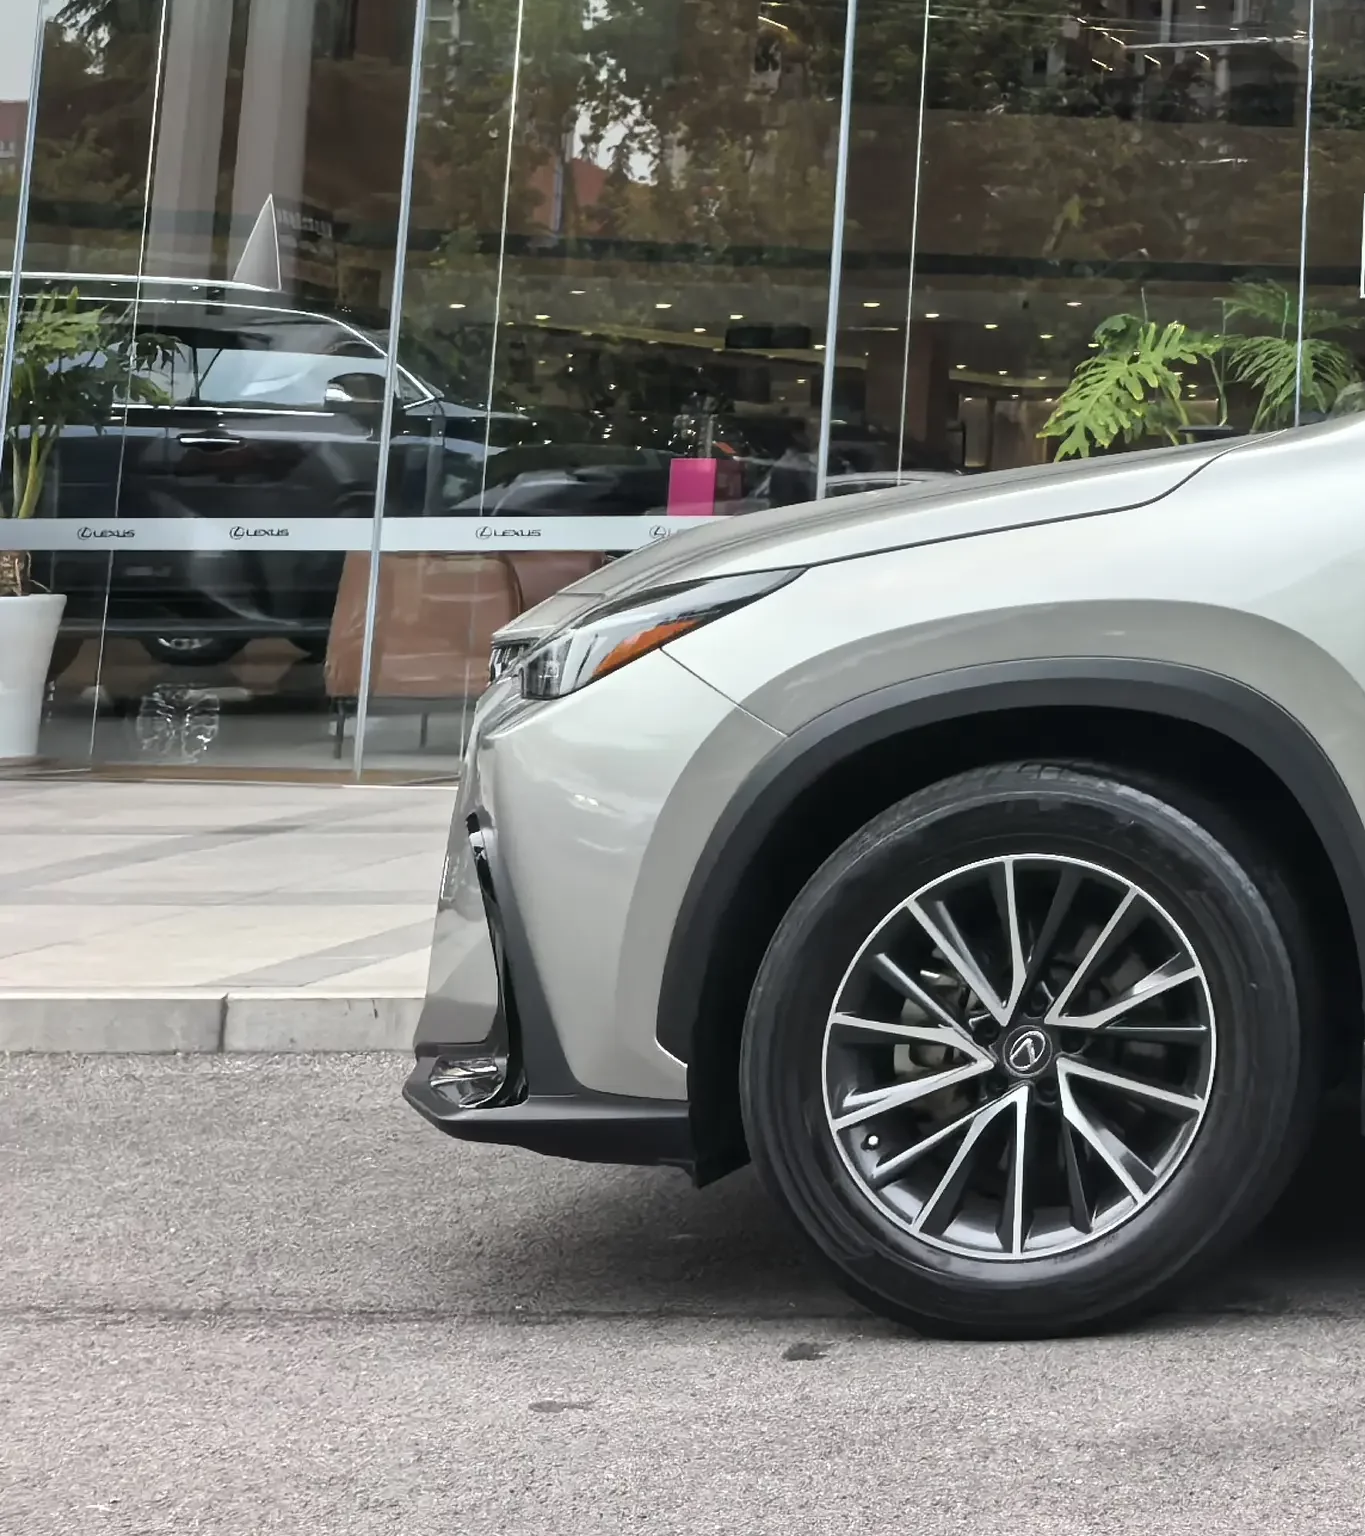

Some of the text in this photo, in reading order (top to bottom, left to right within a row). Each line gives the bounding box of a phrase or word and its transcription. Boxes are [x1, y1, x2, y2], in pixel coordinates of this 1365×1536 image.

[93, 528, 136, 538] LEXUS
[246, 527, 290, 537] LEXUS
[493, 528, 542, 537] LEXUS
